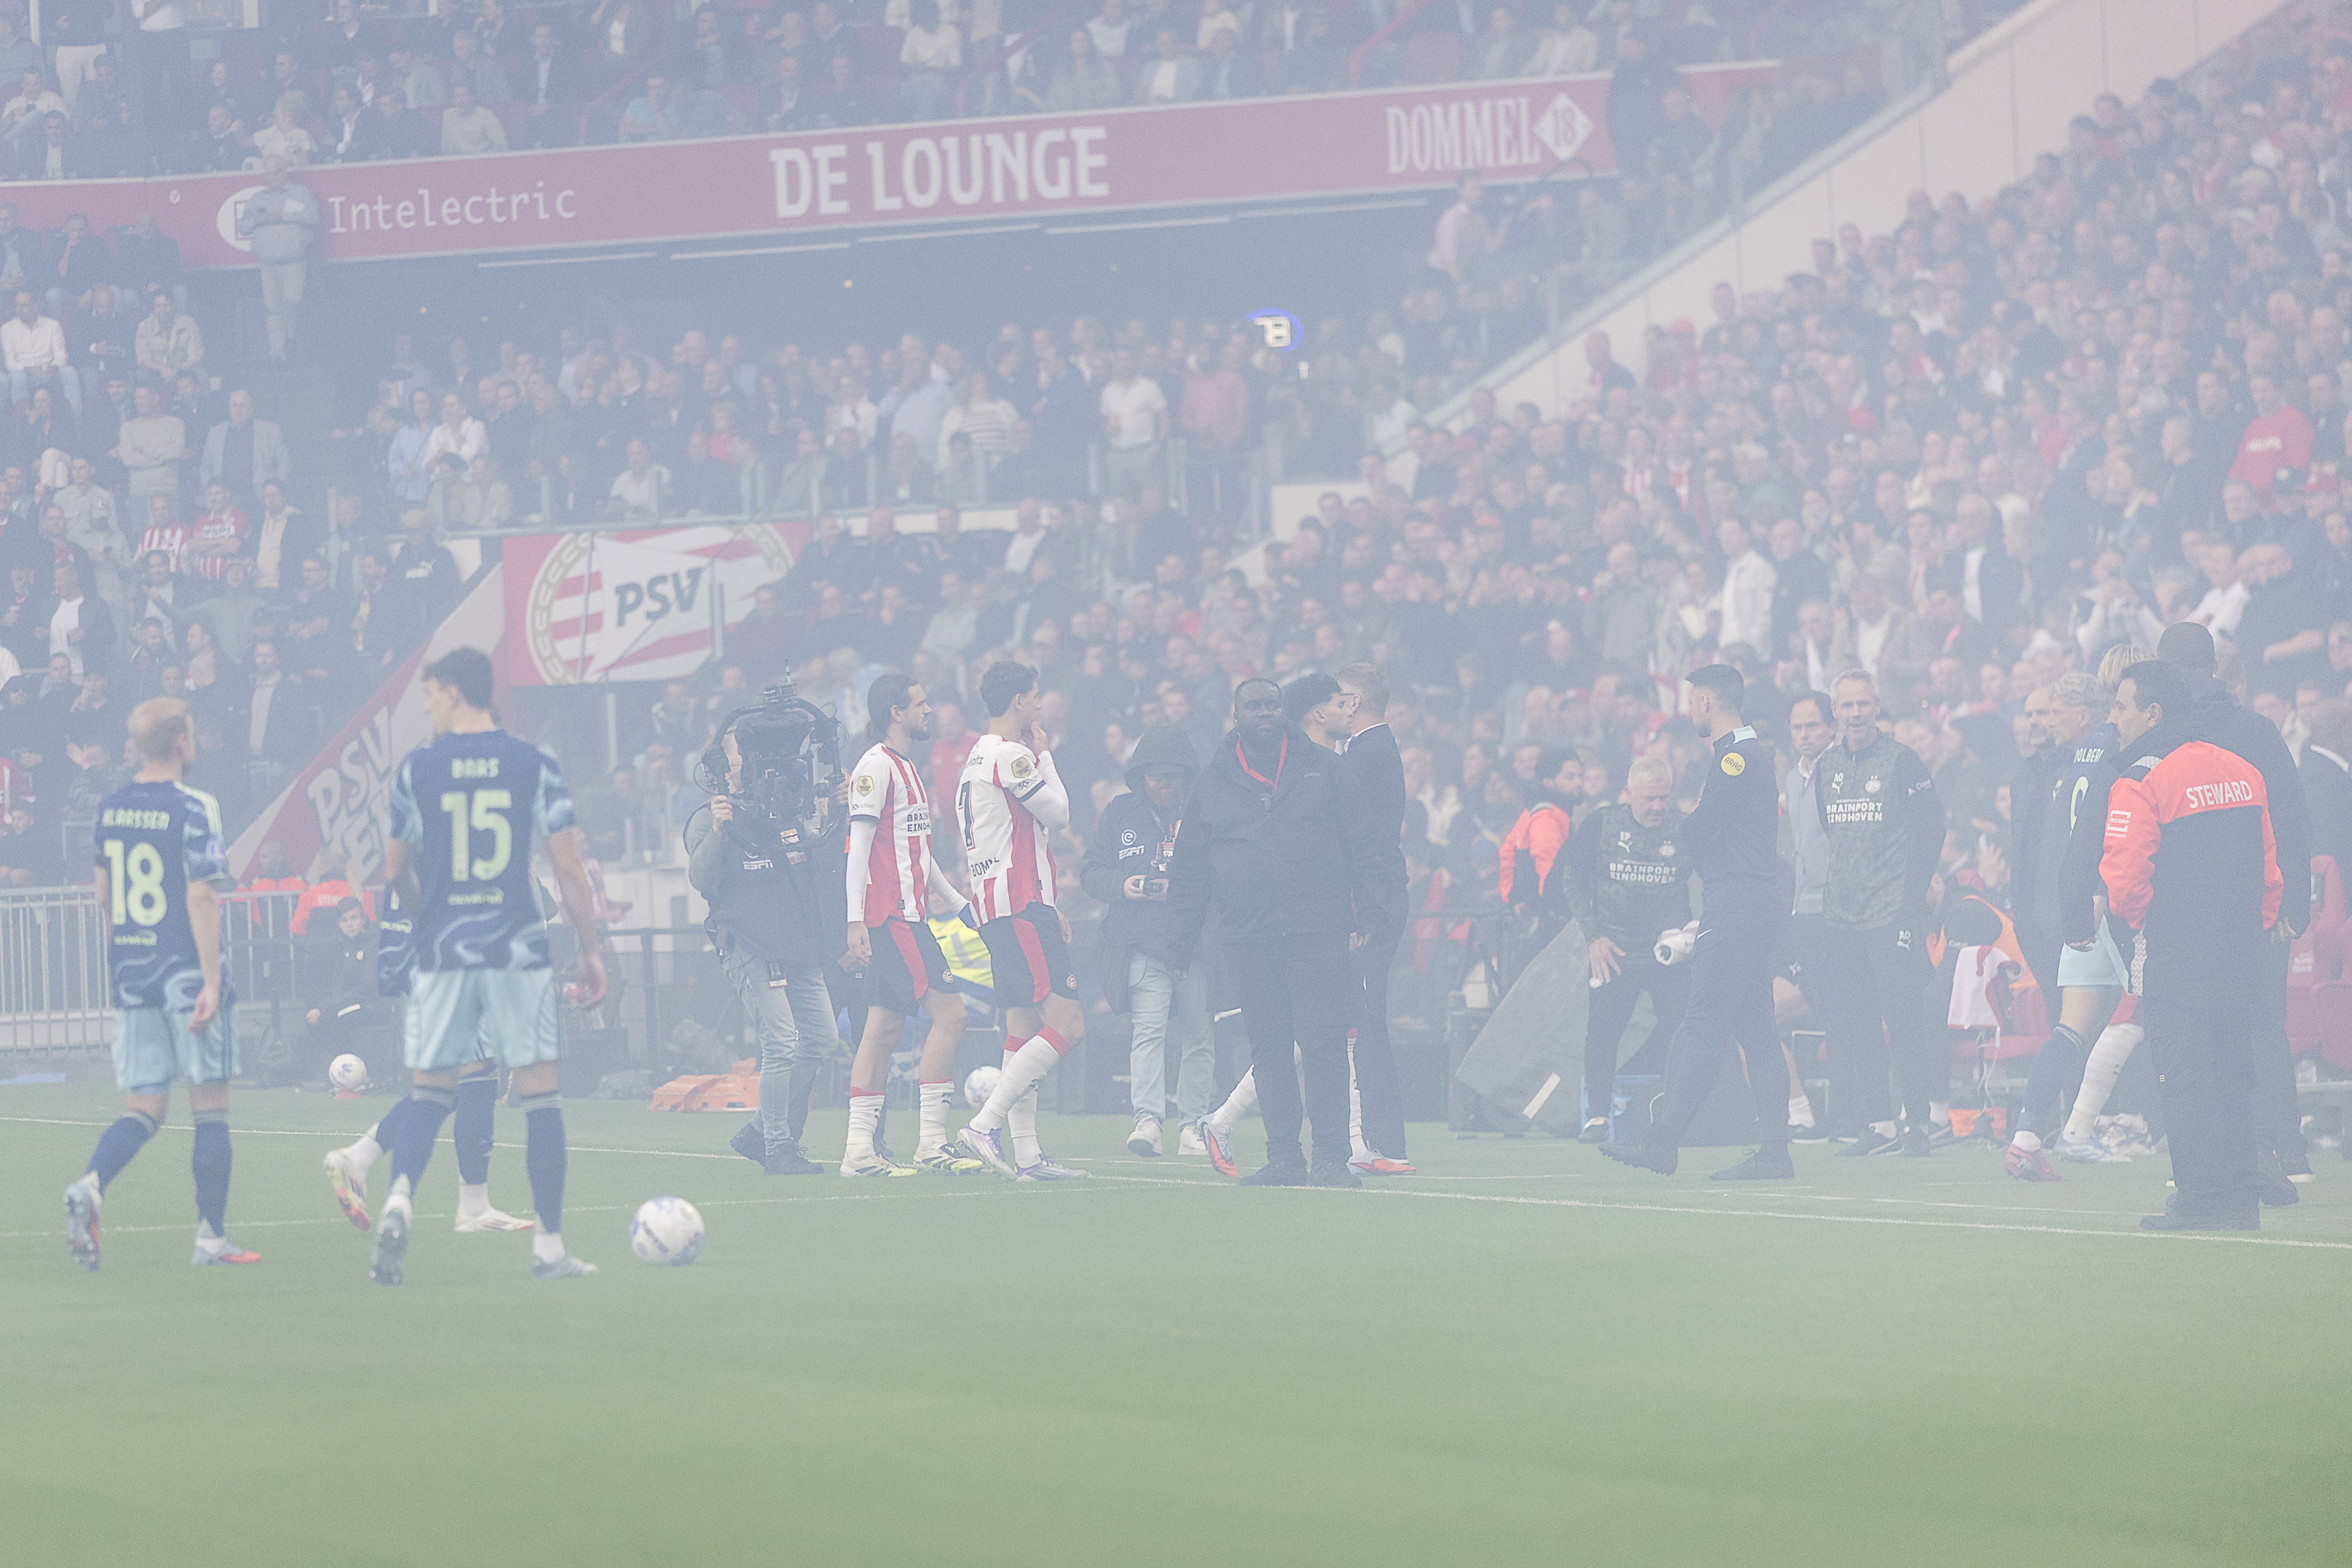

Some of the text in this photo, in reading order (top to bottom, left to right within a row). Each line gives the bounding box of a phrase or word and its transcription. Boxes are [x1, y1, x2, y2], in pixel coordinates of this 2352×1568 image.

[1385, 94, 1541, 175] DOMMEL
[768, 125, 1111, 218] DE LOUNGE
[327, 179, 577, 234] Intelectric
[614, 566, 704, 628] PSV
[1723, 757, 1743, 772] ARAG
[306, 704, 392, 846] PSV
[1834, 773, 1843, 783] AO
[2186, 780, 2253, 809] STEWARD
[1826, 802, 1883, 814] BRAINPORT
[907, 811, 930, 823] BRAIN
[1827, 812, 1883, 824] EINDHOVEN
[441, 789, 512, 882] 15
[1119, 845, 1144, 860] ESPN
[743, 859, 773, 870] ESPN
[1610, 862, 1677, 875] BRAINPORT
[104, 838, 167, 927] 18
[1610, 872, 1676, 884] EINDHOVEN
